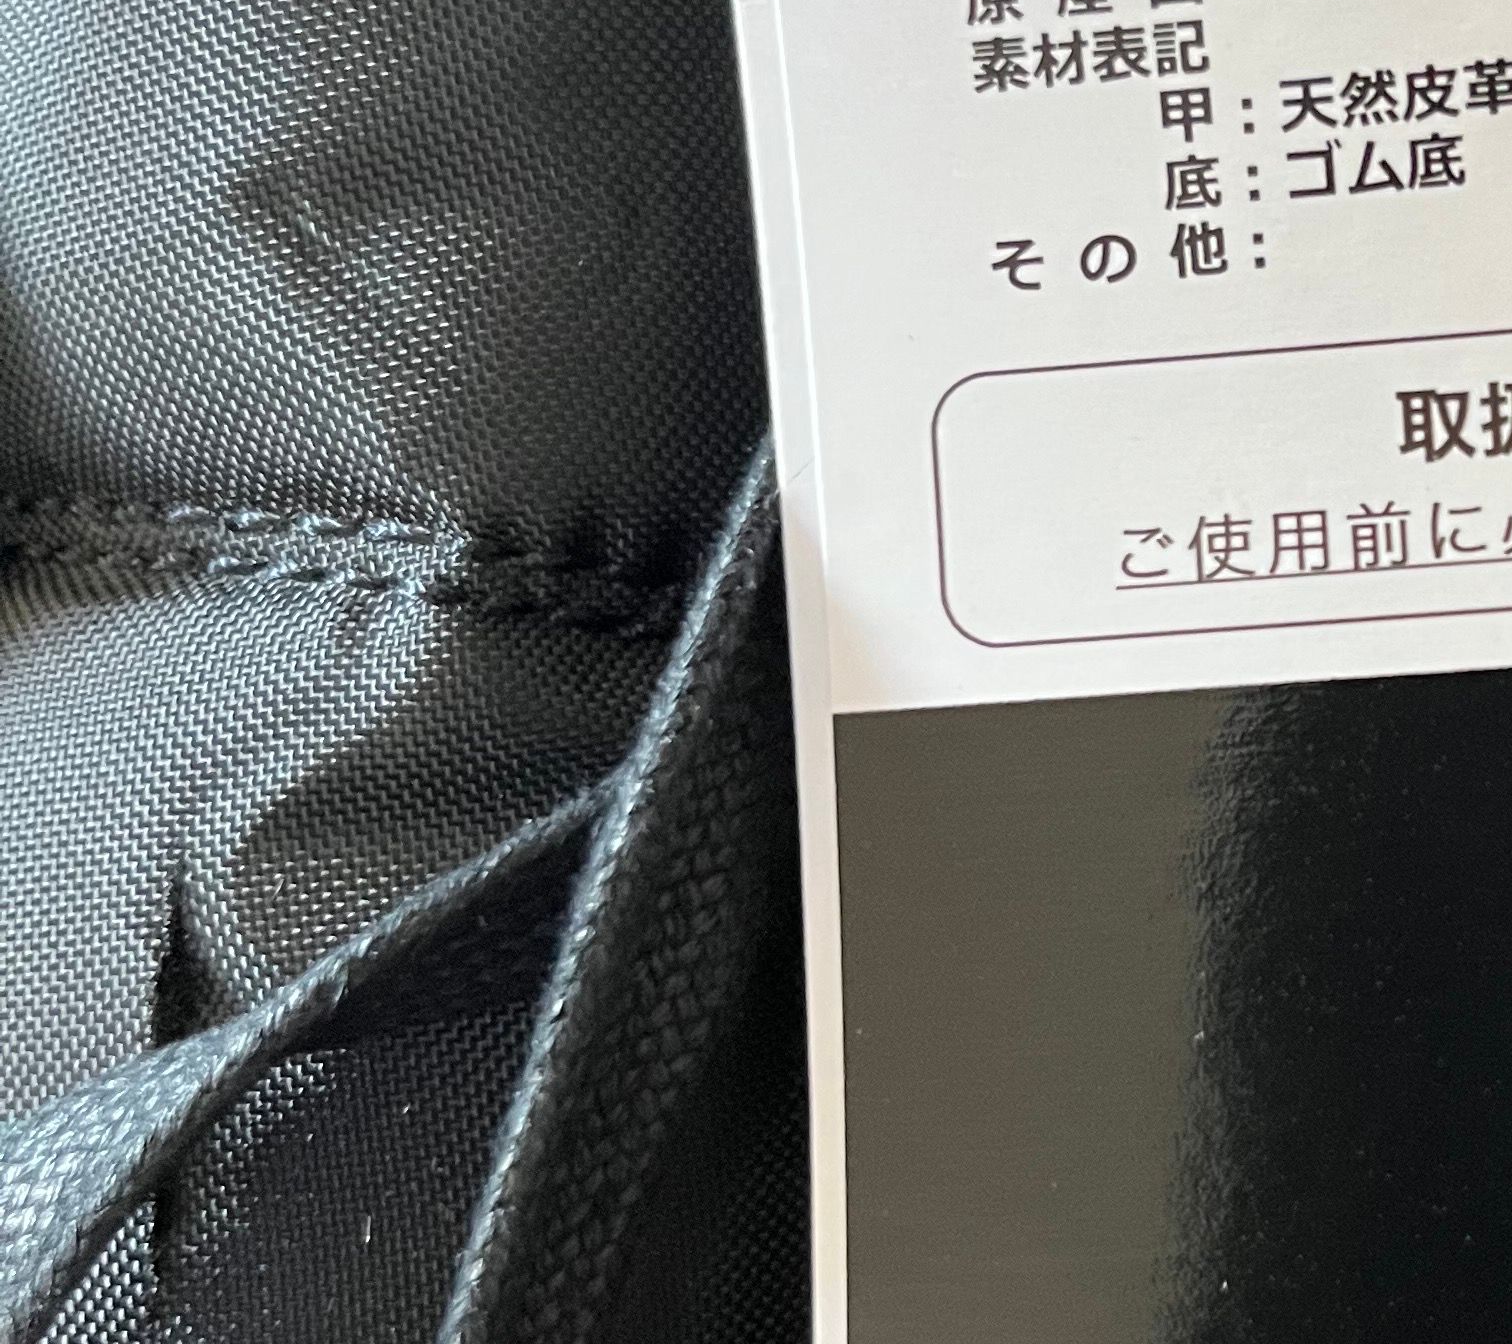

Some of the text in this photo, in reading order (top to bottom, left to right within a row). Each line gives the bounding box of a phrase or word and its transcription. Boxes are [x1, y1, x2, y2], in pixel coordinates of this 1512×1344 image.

[972, 19, 1210, 93] 素材表記
[1286, 132, 1466, 199] ゴム底
